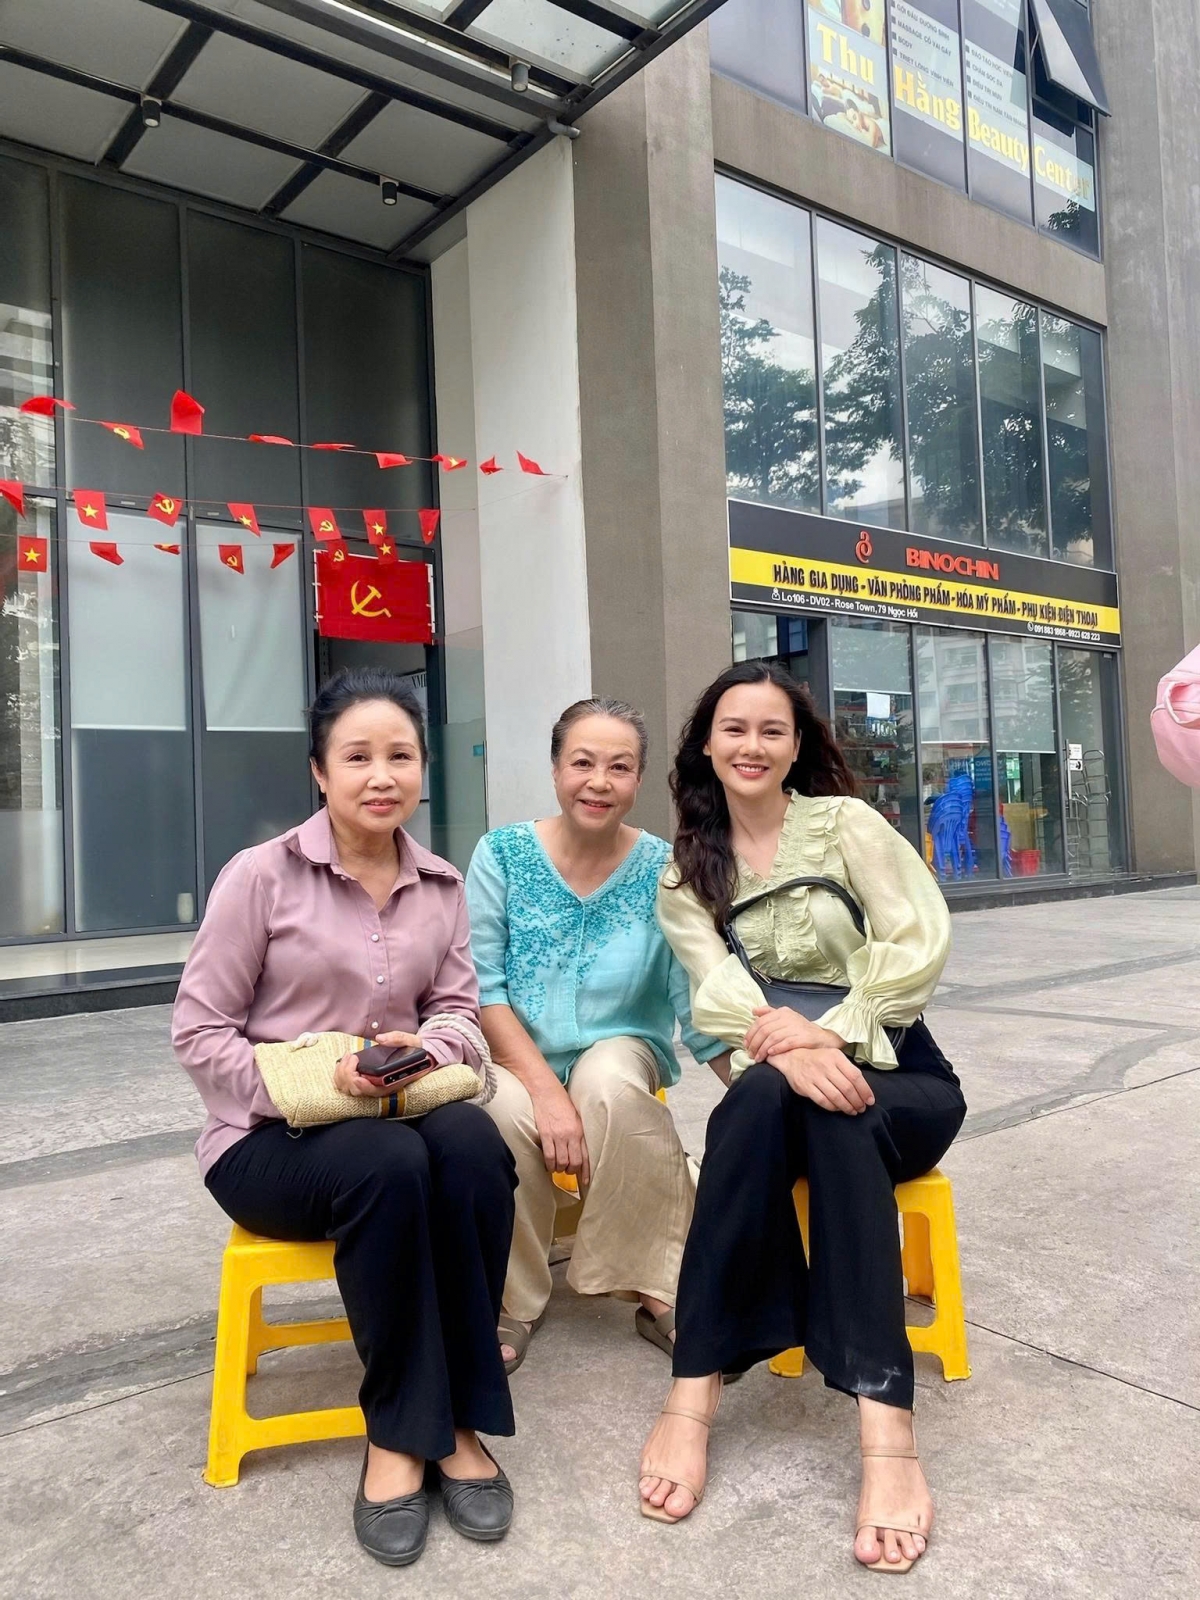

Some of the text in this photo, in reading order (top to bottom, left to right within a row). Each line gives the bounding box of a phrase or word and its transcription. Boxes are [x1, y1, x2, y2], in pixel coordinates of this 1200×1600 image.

[897, 36, 913, 49] BODY
[816, 23, 874, 86] Thu
[894, 63, 961, 131] Hằng
[968, 107, 1030, 173] Beauty
[906, 547, 999, 580] BINOCHIN
[781, 592, 805, 604] Lo106
[810, 595, 830, 607] DV02
[834, 599, 855, 610] Rose
[887, 607, 906, 619] Ngọc
[809, 569, 828, 589] GIA
[831, 573, 859, 595] DỤNG
[867, 575, 888, 598] VĂN
[889, 578, 921, 602] PHÒNG
[956, 588, 974, 609] HÓA
[1021, 602, 1038, 621] PHỤ
[1075, 610, 1098, 630] THOẠI
[1091, 631, 1100, 641] 223
